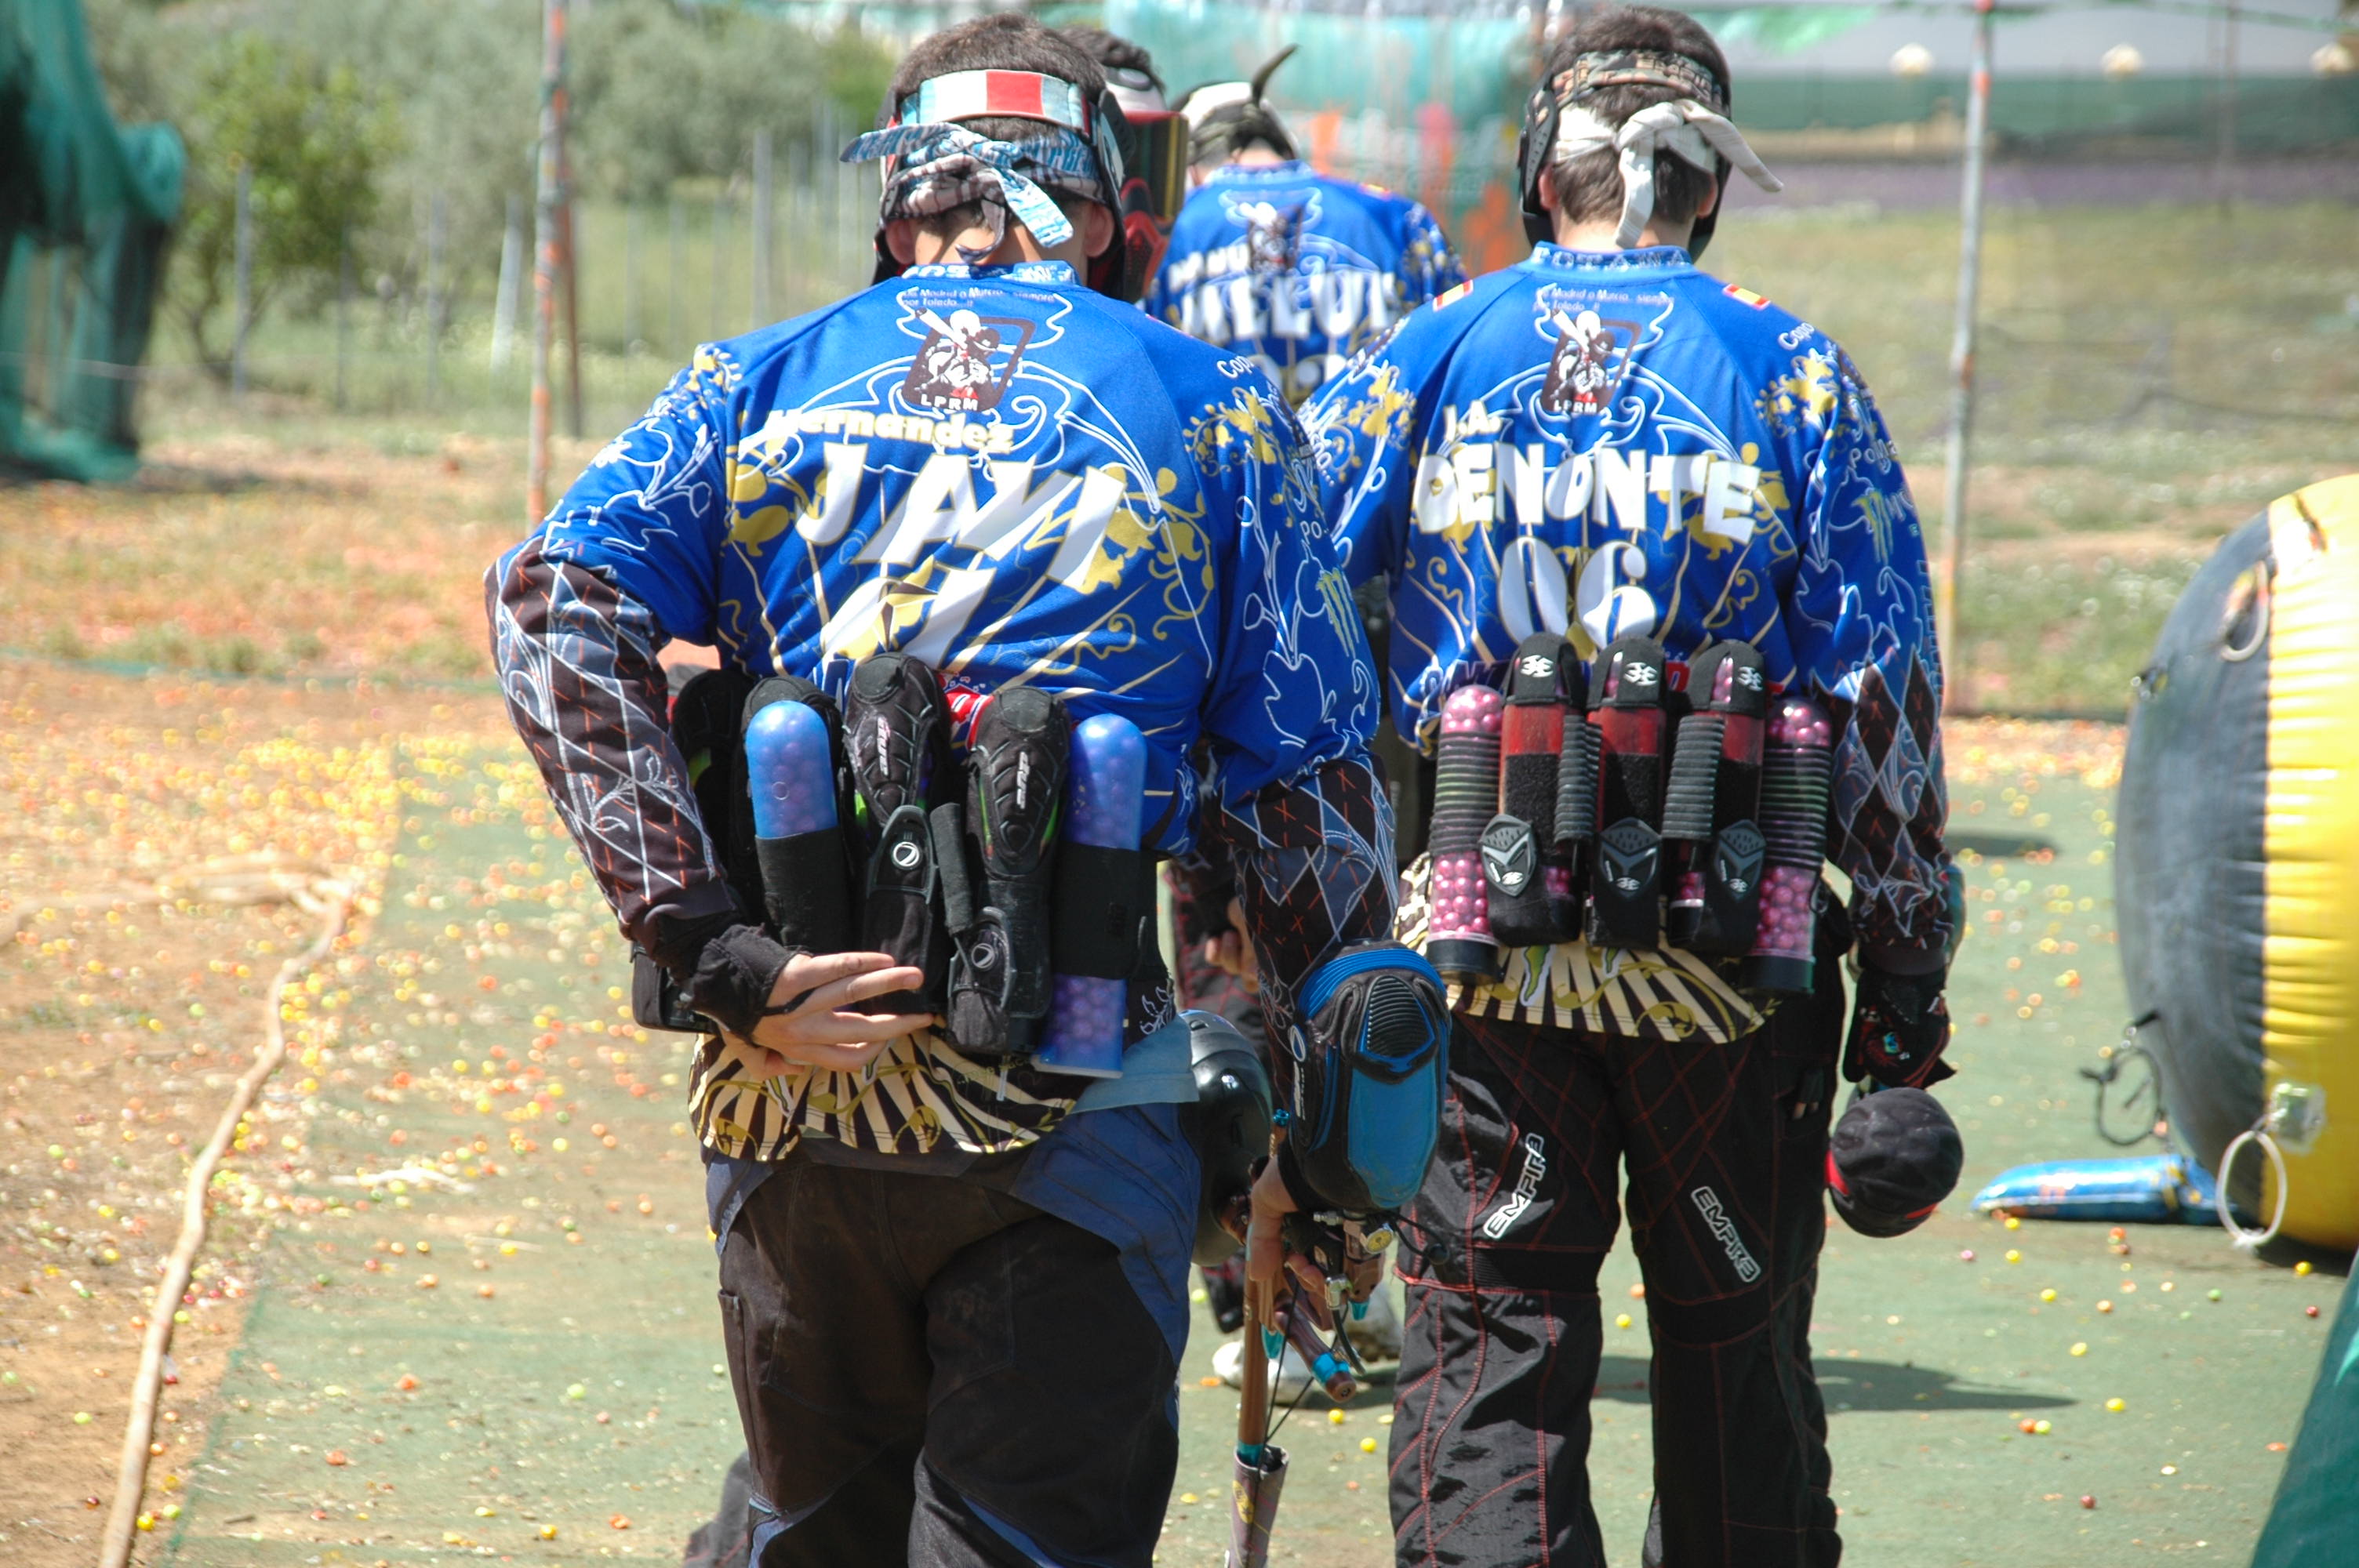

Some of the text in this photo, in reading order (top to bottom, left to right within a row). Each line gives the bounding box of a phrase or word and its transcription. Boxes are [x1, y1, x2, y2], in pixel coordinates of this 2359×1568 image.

[920, 394, 979, 411] LPRM
[1216, 354, 1256, 379] Cop
[768, 409, 1015, 455] Hernandez
[1553, 399, 1598, 413] LPRM
[795, 442, 1127, 587] JAVI
[1499, 536, 1656, 649] 06
[1482, 1132, 1547, 1240] EMPIRE
[1690, 1185, 1761, 1283] EMPIRE
